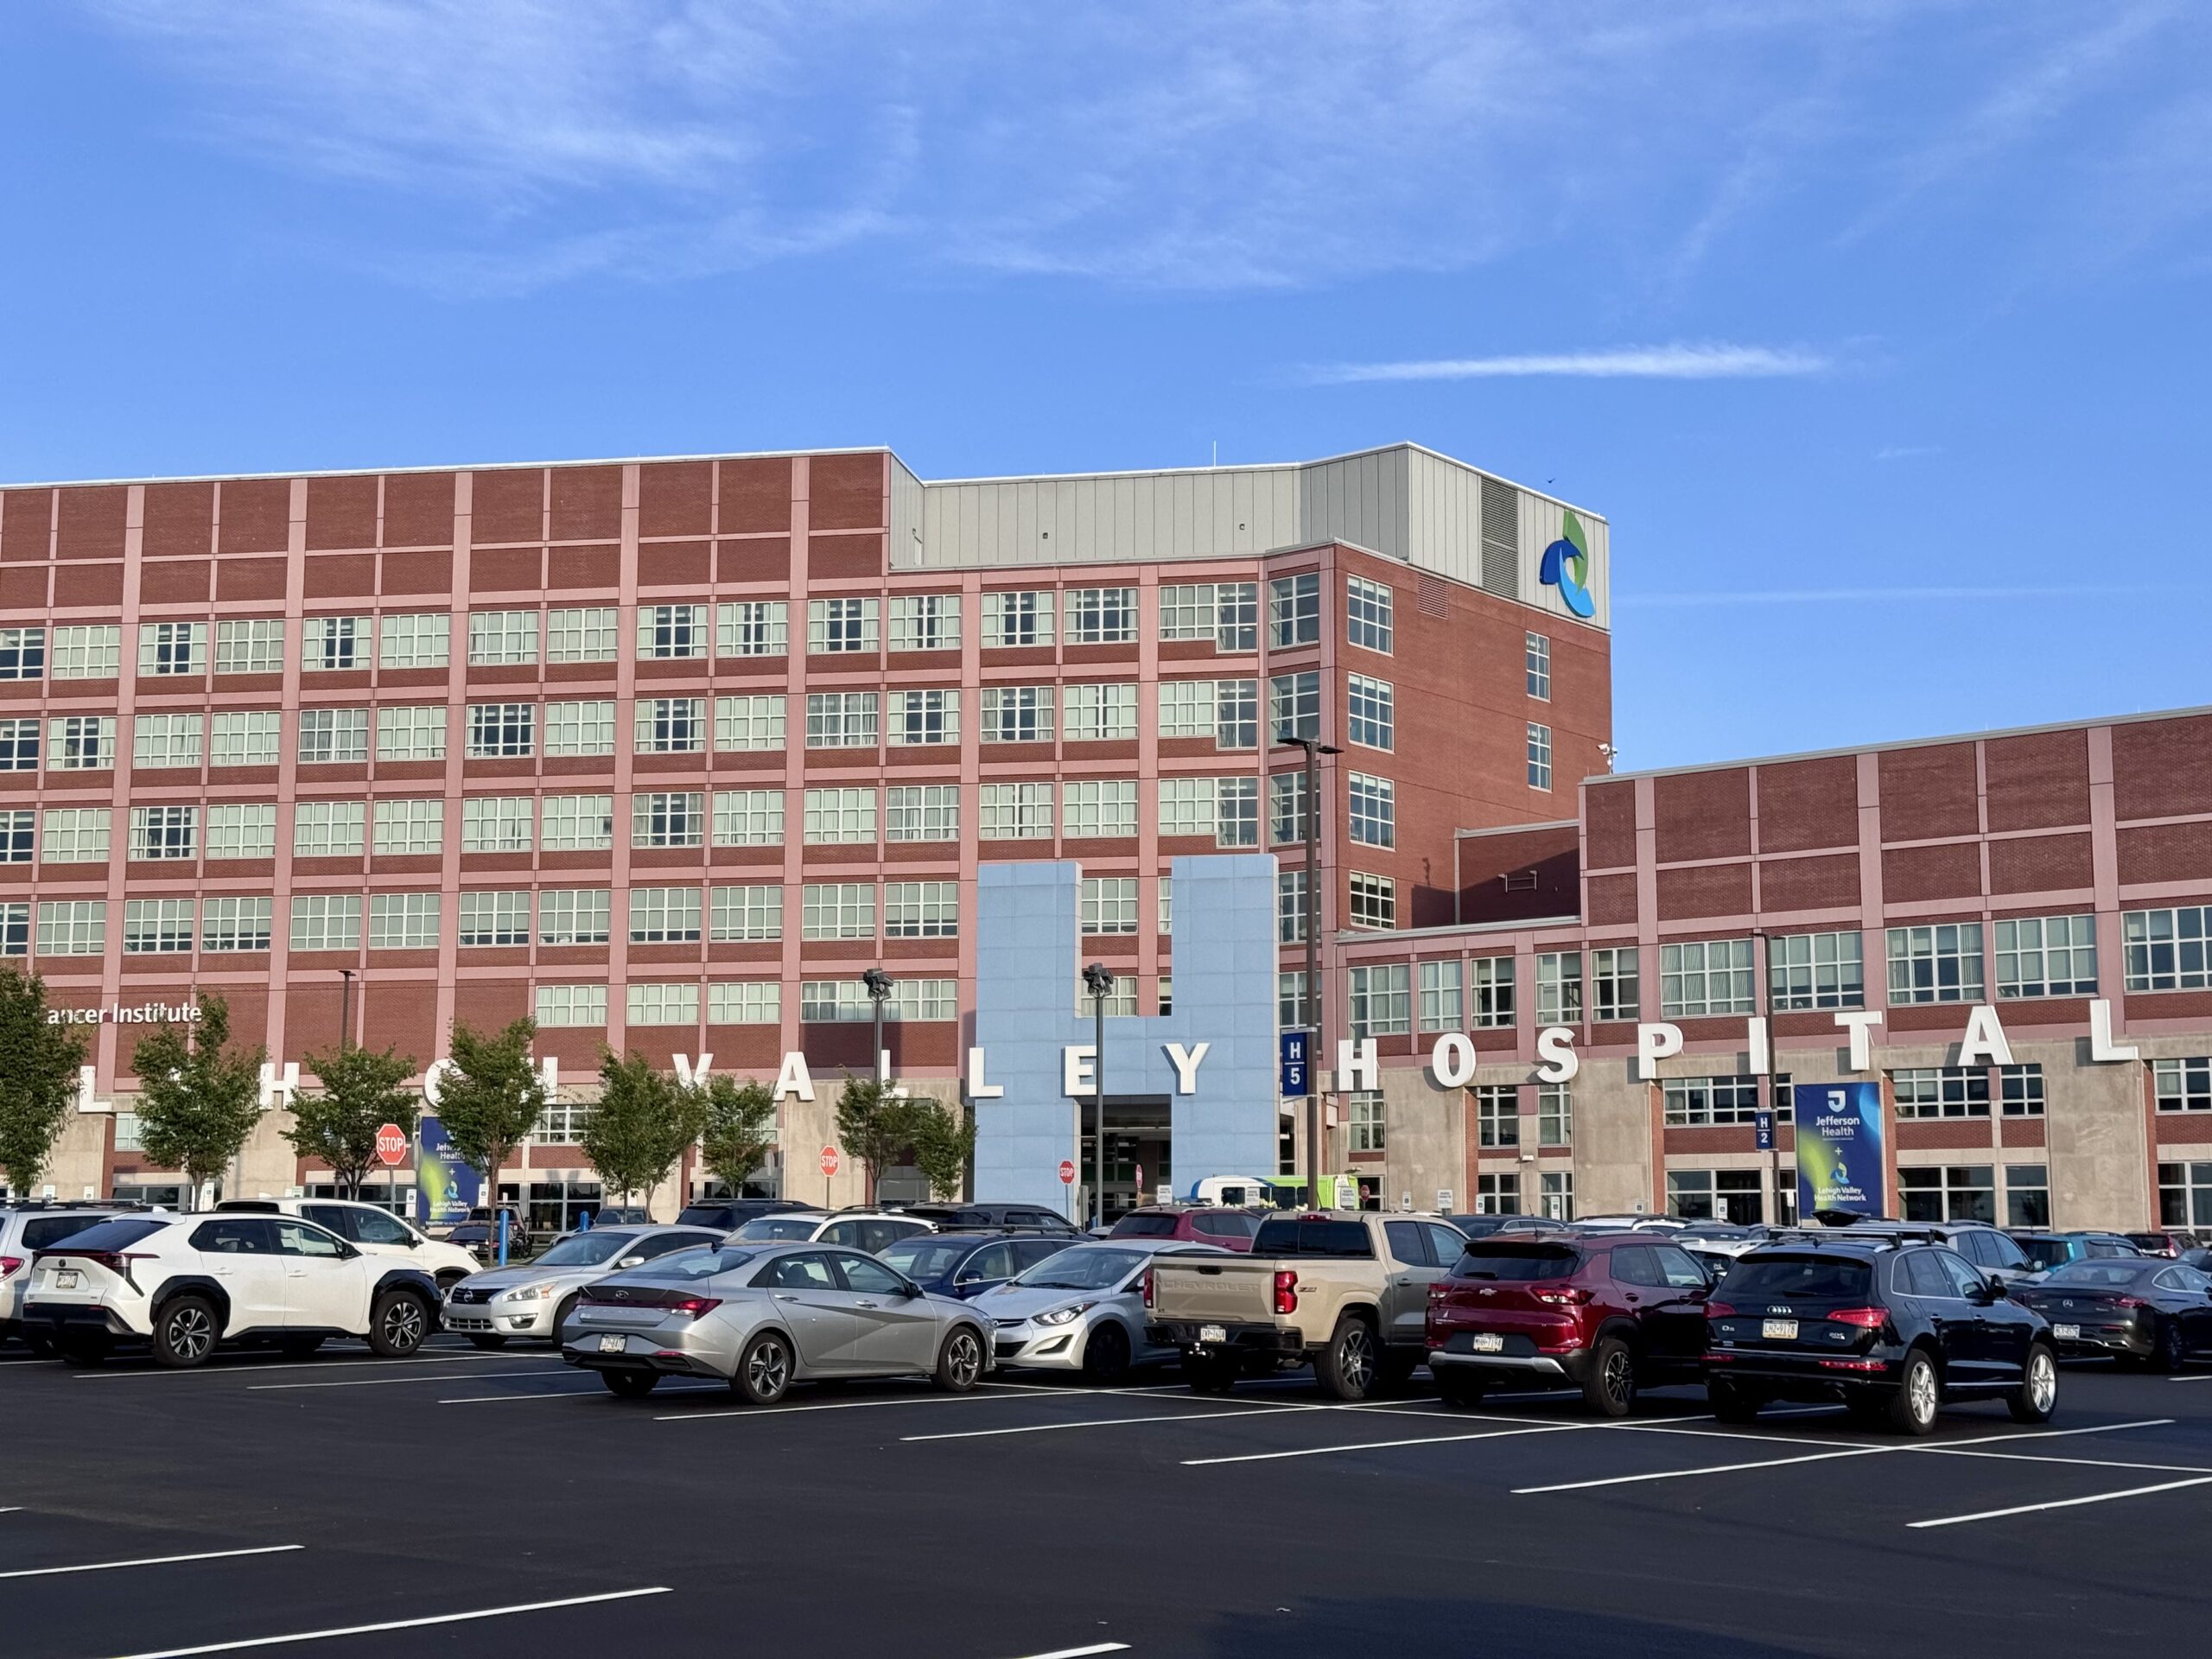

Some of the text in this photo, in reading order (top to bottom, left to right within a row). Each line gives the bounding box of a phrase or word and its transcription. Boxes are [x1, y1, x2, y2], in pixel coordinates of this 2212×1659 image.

[47, 1001, 203, 1025] ancer Institute
[78, 1056, 558, 1113] LHH
[1338, 999, 2139, 1092] HOSPITAL
[1290, 1041, 1301, 1059] H
[1290, 1067, 1300, 1085] 5
[1760, 1116, 1769, 1128] H
[1815, 1116, 1860, 1127] Jefferson
[1821, 1126, 1854, 1136] Health
[1760, 1132, 1769, 1144] 2
[378, 1136, 404, 1153] STOP
[821, 1155, 838, 1167] STOP
[1060, 1167, 1074, 1178] STOP
[1818, 1185, 1862, 1195] Lehigh Valley
[1814, 1193, 1866, 1202] Health Network
[1164, 1279, 1259, 1293] CHEVROLET
